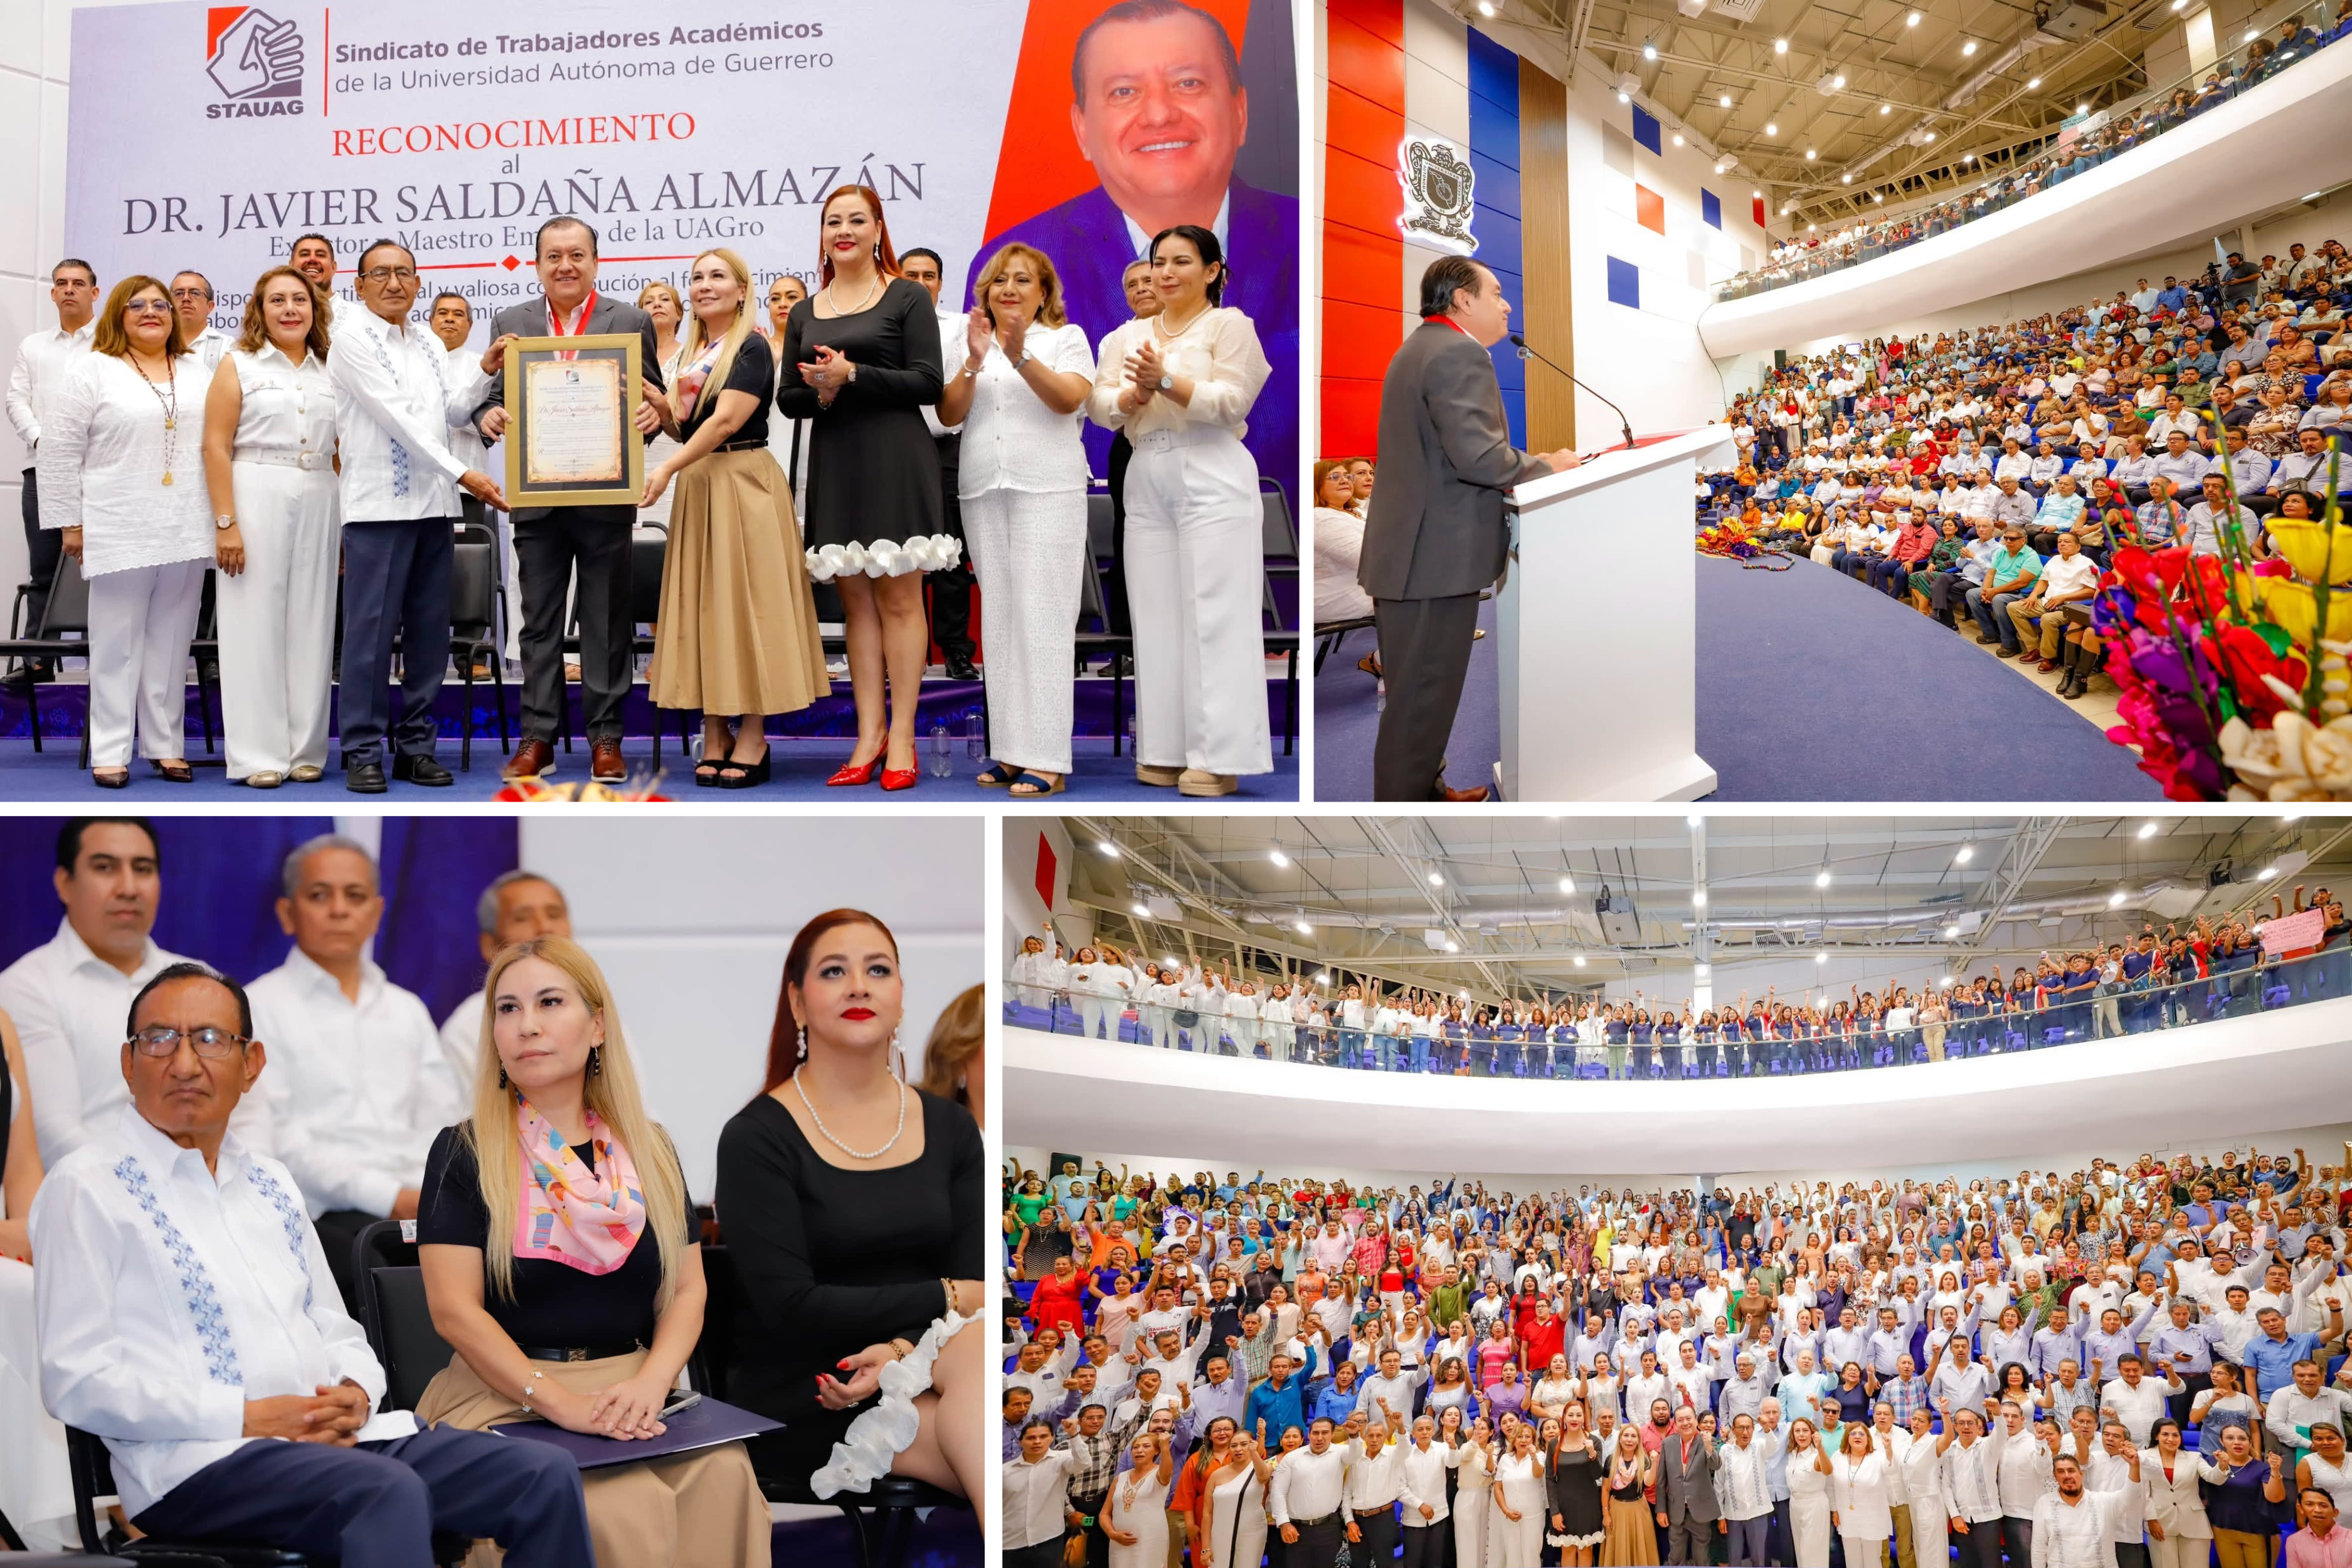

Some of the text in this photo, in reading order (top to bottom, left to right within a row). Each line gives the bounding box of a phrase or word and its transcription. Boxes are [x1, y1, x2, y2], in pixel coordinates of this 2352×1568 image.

[336, 22, 823, 63] Sindicato de Trabajadores Académicos
[336, 53, 833, 93] de la Universidad Autónoma de Guerrero
[206, 100, 304, 119] STAUAG
[332, 113, 696, 157] RECONOCIMIENTO
[502, 154, 519, 174] al
[1424, 161, 1459, 179] UNIVERSIDAD
[123, 152, 926, 238] DR. JAVIER SALDAÑA ALMAZÁN
[398, 230, 493, 251] Maestro
[608, 220, 636, 242] de
[645, 218, 665, 240] la
[675, 216, 764, 239] UAGro
[454, 279, 520, 297] valiosa
